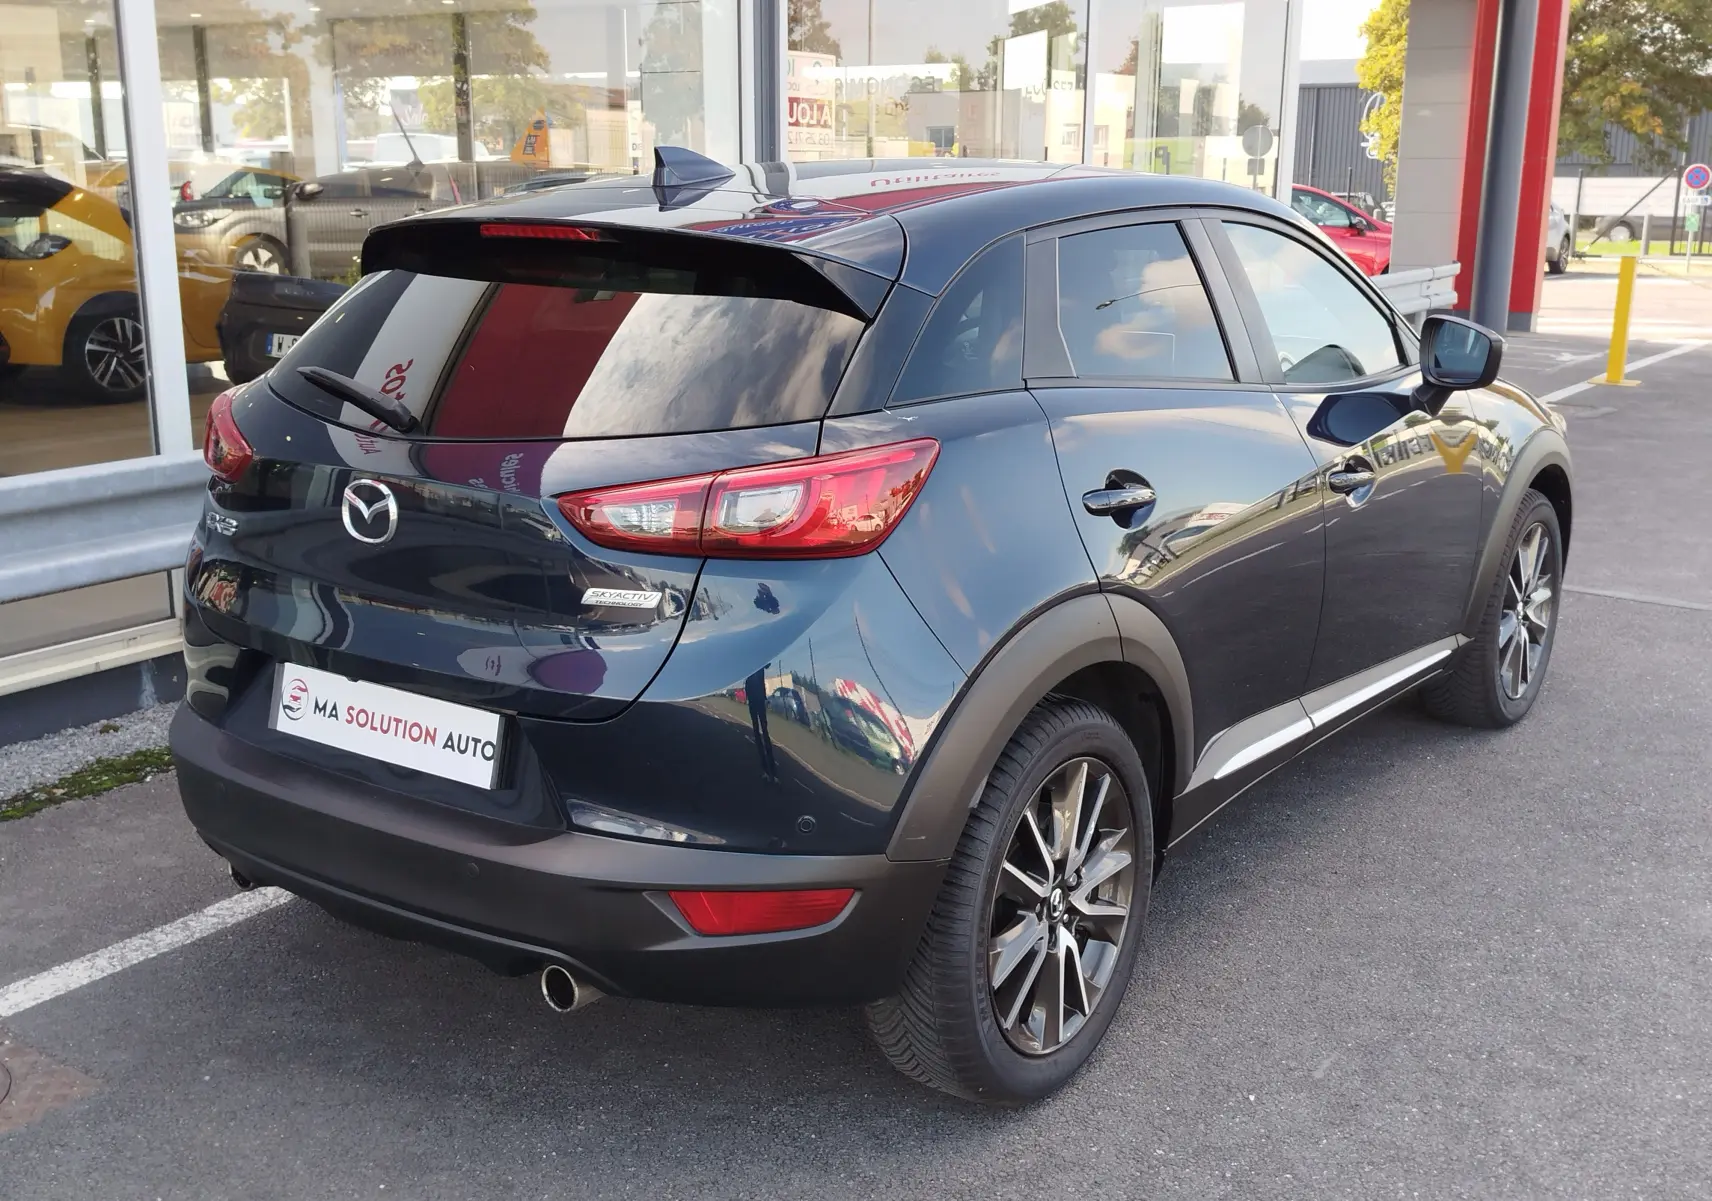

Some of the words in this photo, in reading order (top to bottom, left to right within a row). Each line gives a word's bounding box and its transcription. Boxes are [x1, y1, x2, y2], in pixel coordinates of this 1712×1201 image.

[590, 590, 655, 600] SKYACTIV
[313, 696, 339, 721] MA
[345, 705, 438, 747] SOLUTION
[442, 731, 496, 761] AUTO
